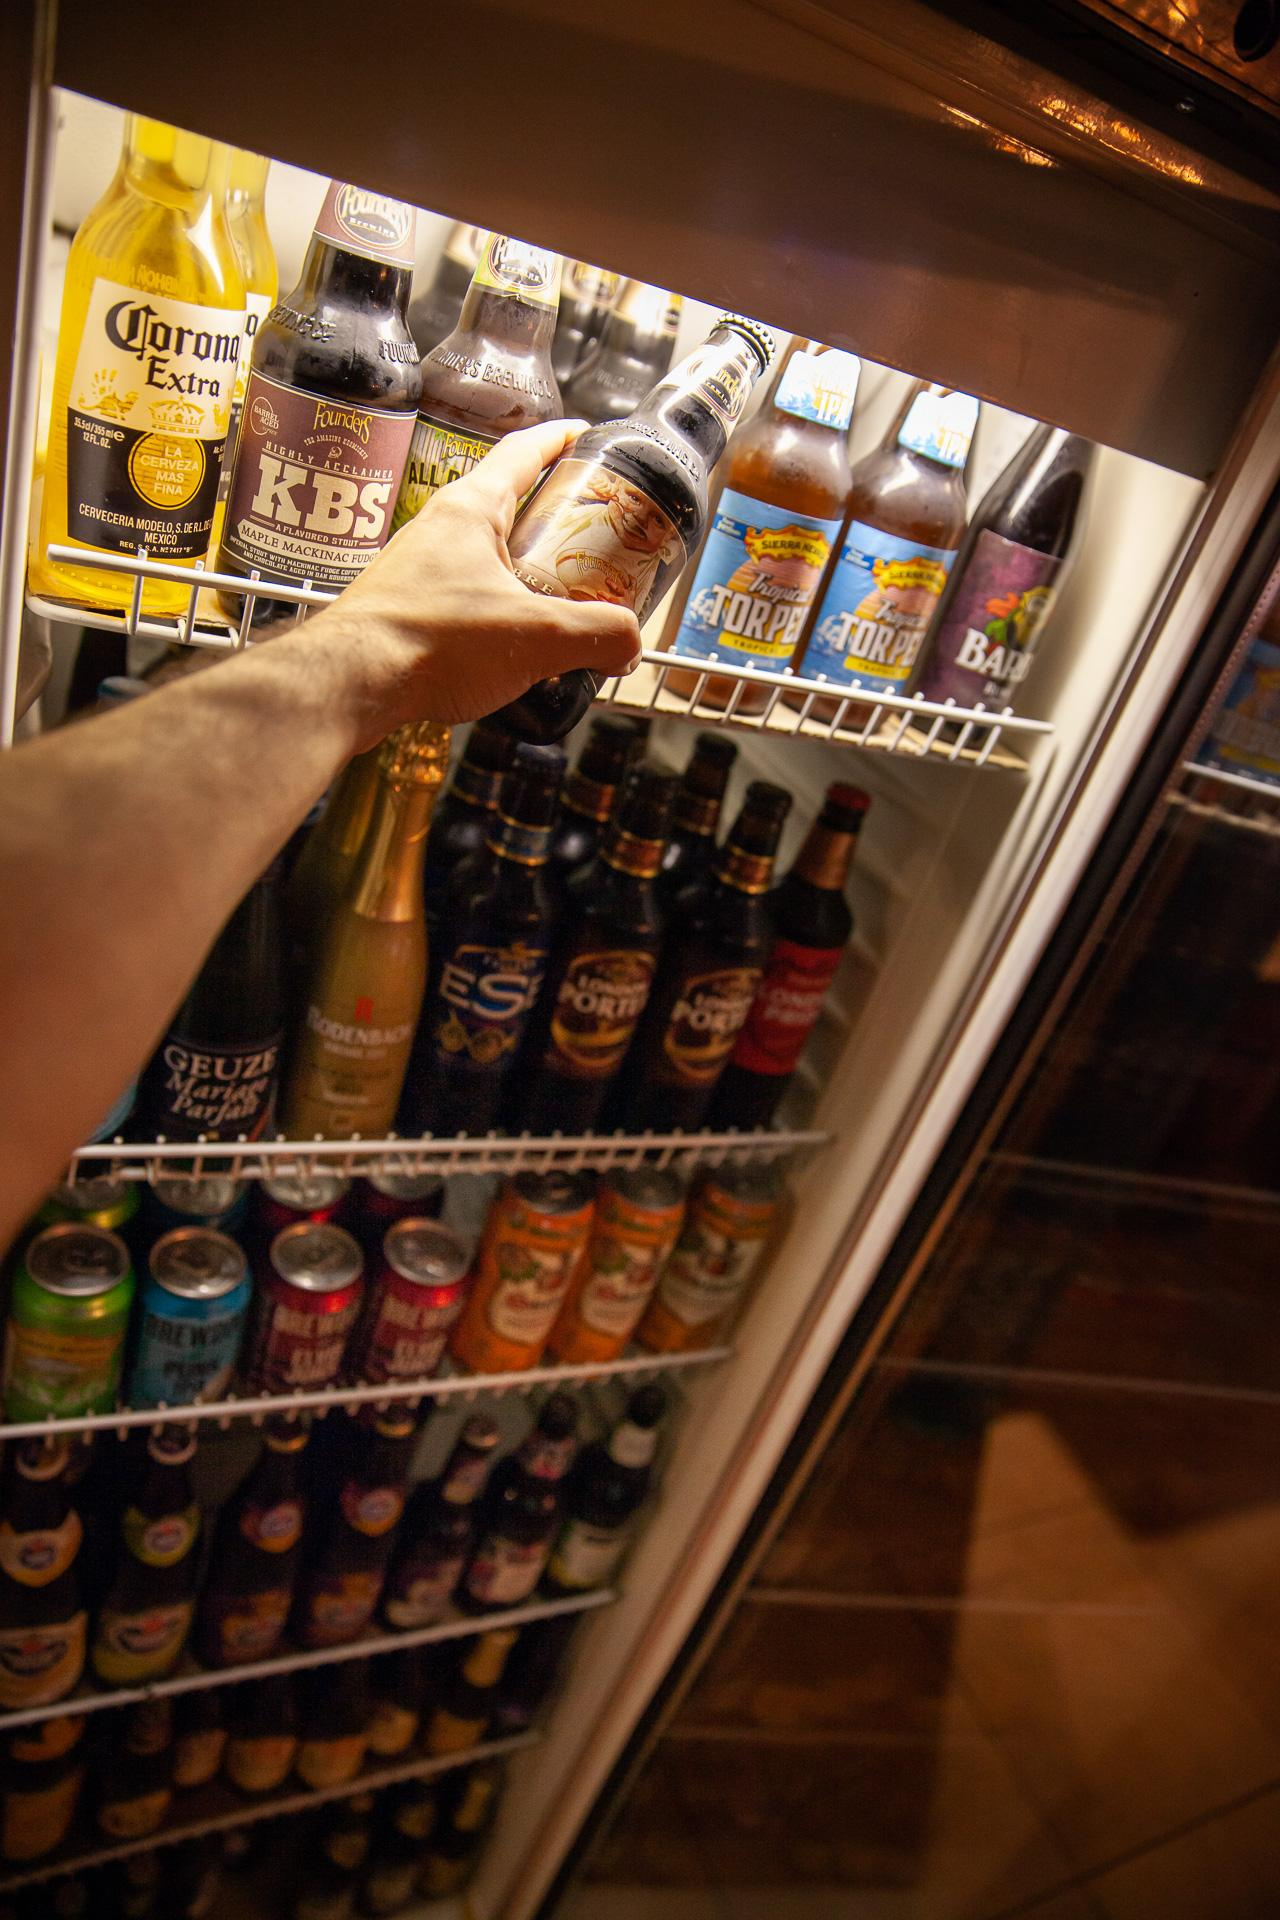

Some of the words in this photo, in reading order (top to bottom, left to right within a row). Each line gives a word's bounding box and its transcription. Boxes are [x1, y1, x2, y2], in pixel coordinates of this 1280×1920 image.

[105, 301, 240, 363] Corona
[145, 355, 220, 397] Extra
[254, 405, 280, 422] BARREL
[260, 416, 279, 430] AGED
[313, 401, 373, 445] Founders
[140, 454, 200, 472] CERVEZA
[164, 446, 182, 458] LA
[266, 440, 314, 465] HIGHLY
[324, 461, 393, 478] ACCLAIMED
[155, 470, 185, 483] MAS
[408, 462, 440, 489] ALL
[153, 482, 183, 496] FINA
[251, 453, 393, 540] KBS
[79, 503, 134, 528] CERVECERIA
[136, 518, 175, 535] MODELO,
[119, 541, 136, 550] REG.
[144, 531, 178, 546] MEXICO
[240, 524, 279, 548] MAPLE
[281, 541, 351, 563] MACKINAC
[351, 552, 377, 564] FUDG
[275, 523, 281, 532] A
[283, 525, 329, 543] FLAVORED
[331, 537, 359, 548] STOUT
[269, 553, 286, 565] WITH
[708, 583, 811, 646] TORPE
